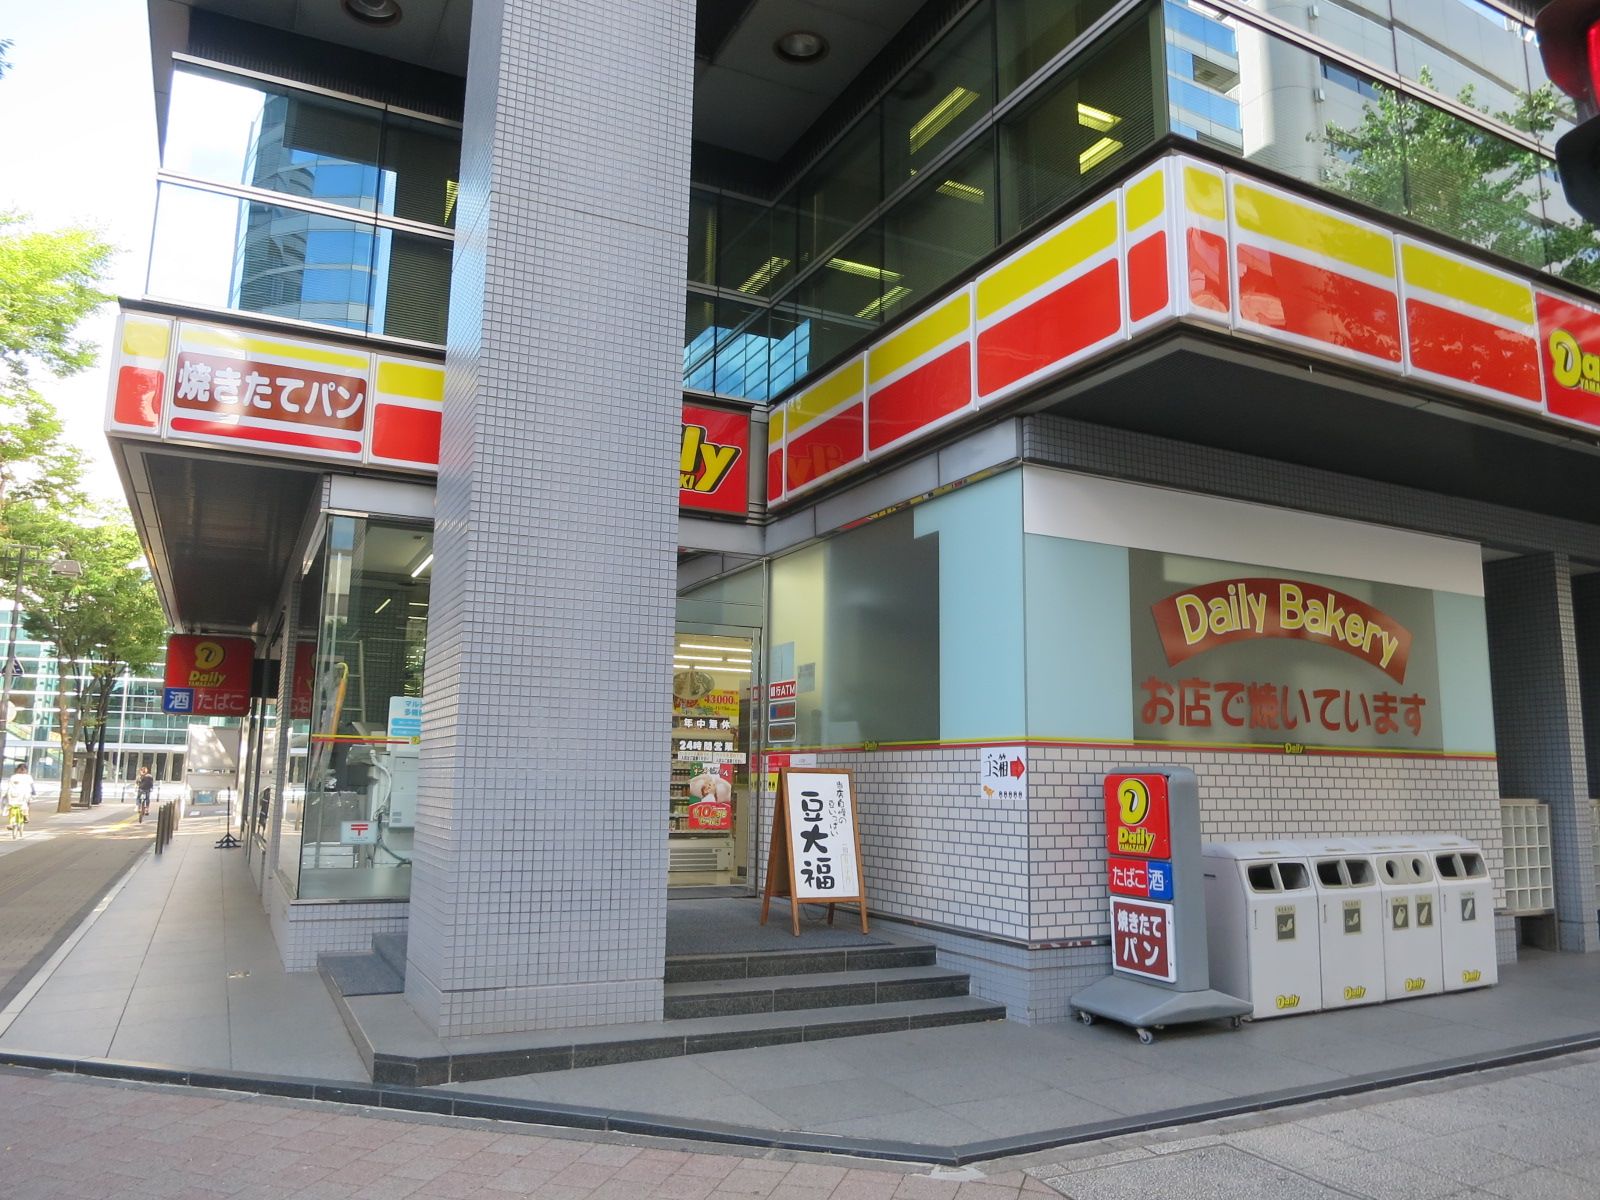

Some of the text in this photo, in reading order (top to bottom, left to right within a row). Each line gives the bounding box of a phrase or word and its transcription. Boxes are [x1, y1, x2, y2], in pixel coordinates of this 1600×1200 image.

[177, 361, 364, 419] 焼きたてパン
[1174, 582, 1399, 670] Daily Bakery
[189, 670, 226, 688] Daily
[169, 690, 245, 711] 酒 たばこ
[1140, 674, 1427, 737] お店で焼いています
[684, 718, 731, 730] 年中無休
[1285, 743, 1304, 755] Daily
[800, 790, 835, 890] 豆大福
[1118, 826, 1155, 851] Daily
[1112, 865, 1164, 892] たばこ 酒
[1117, 908, 1162, 938] 焼きたて
[1123, 936, 1159, 967] パン
[1405, 976, 1427, 992] Daily
[1462, 968, 1482, 984] Daily
[1276, 994, 1301, 1010] Daily
[1344, 985, 1367, 1001] Daily
